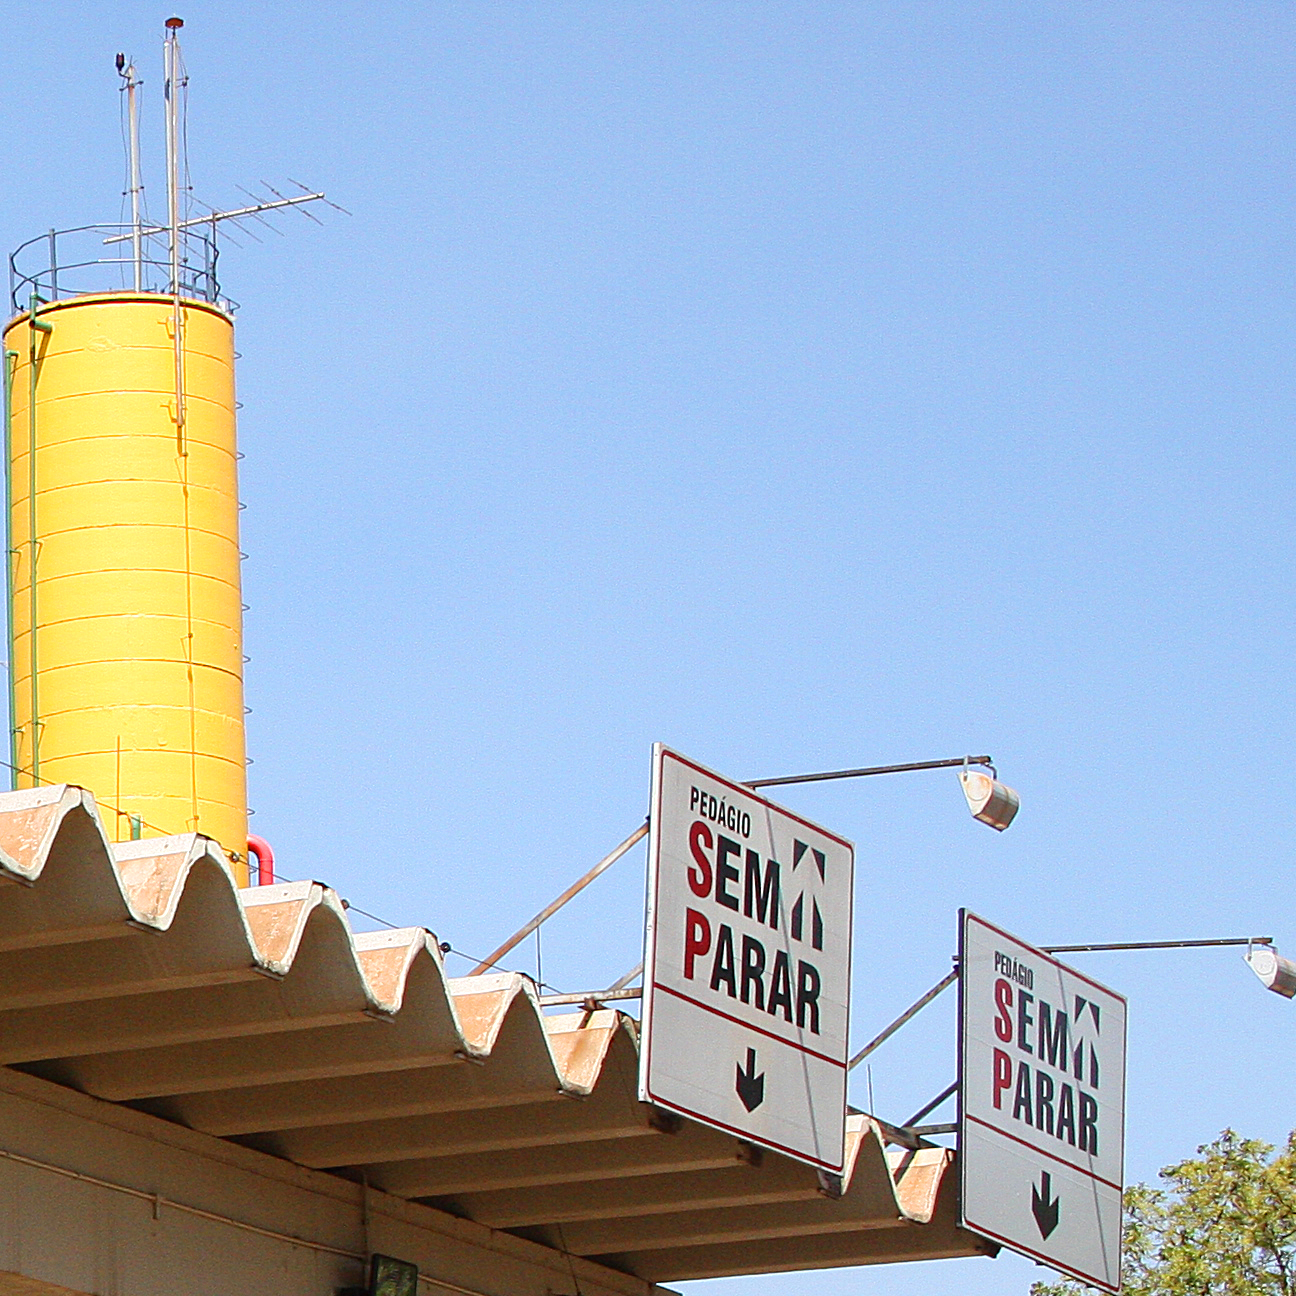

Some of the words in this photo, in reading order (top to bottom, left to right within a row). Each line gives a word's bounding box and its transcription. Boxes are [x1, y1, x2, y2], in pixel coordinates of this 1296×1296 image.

[690, 785, 751, 838] PEDÁGIO
[687, 820, 780, 930] SEM
[684, 906, 821, 1035] PARAR
[994, 951, 1033, 990] PEDÁGIO
[994, 978, 1068, 1072] SEM
[992, 1046, 1098, 1157] PARAR
